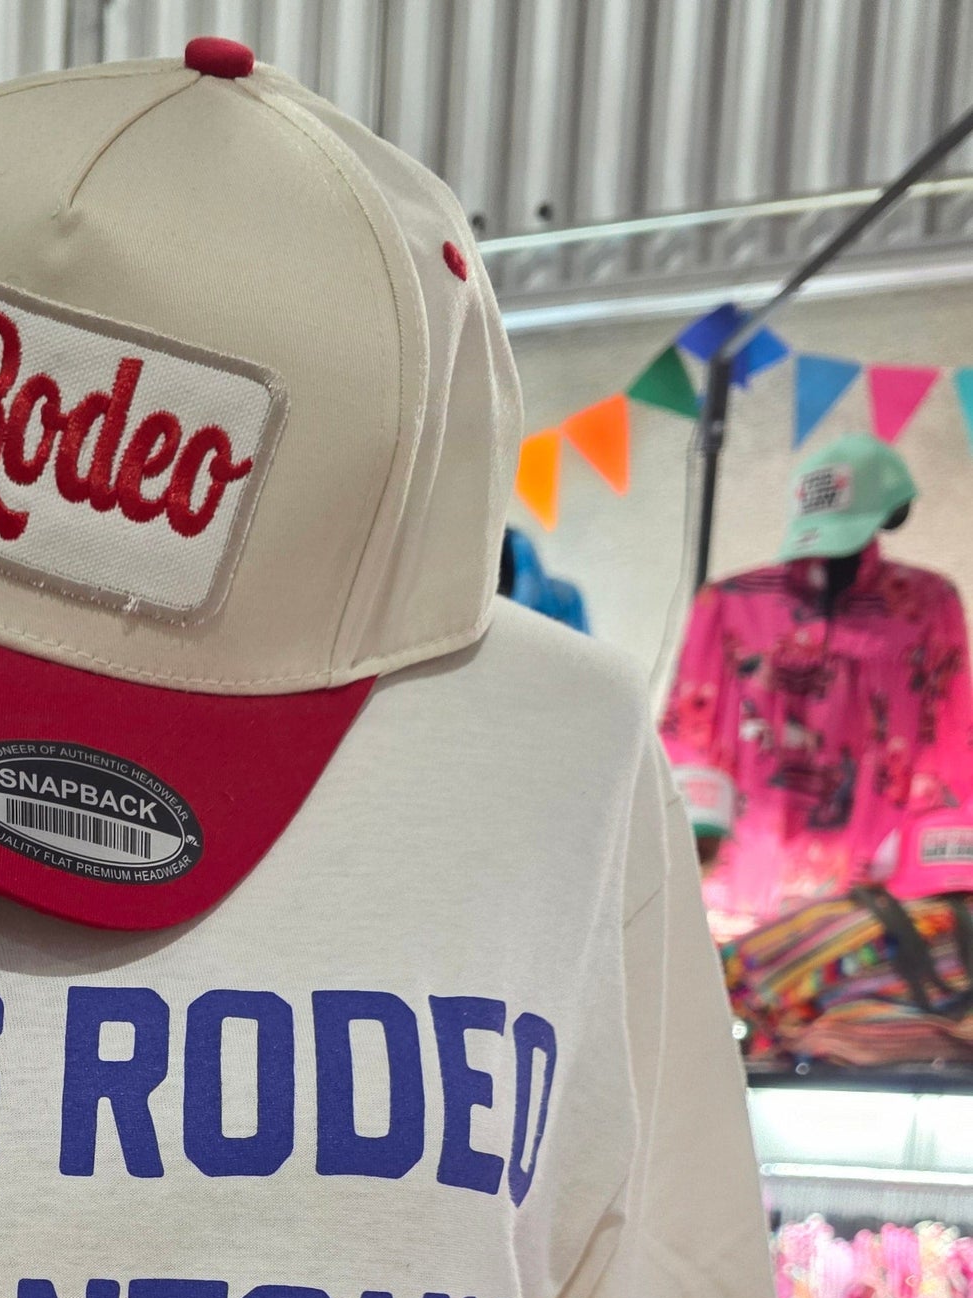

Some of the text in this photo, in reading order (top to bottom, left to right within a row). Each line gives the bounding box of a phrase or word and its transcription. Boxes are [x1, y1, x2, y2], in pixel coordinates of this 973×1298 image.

[39, 745, 57, 755] OF
[59, 747, 129, 774] AUTHENTIC
[131, 768, 189, 822] HEADWEAR
[43, 851, 73, 869] FLAT
[76, 862, 132, 881] PREMIUM
[134, 854, 193, 882] HEADWEAR
[59, 986, 558, 1209] RODEO
